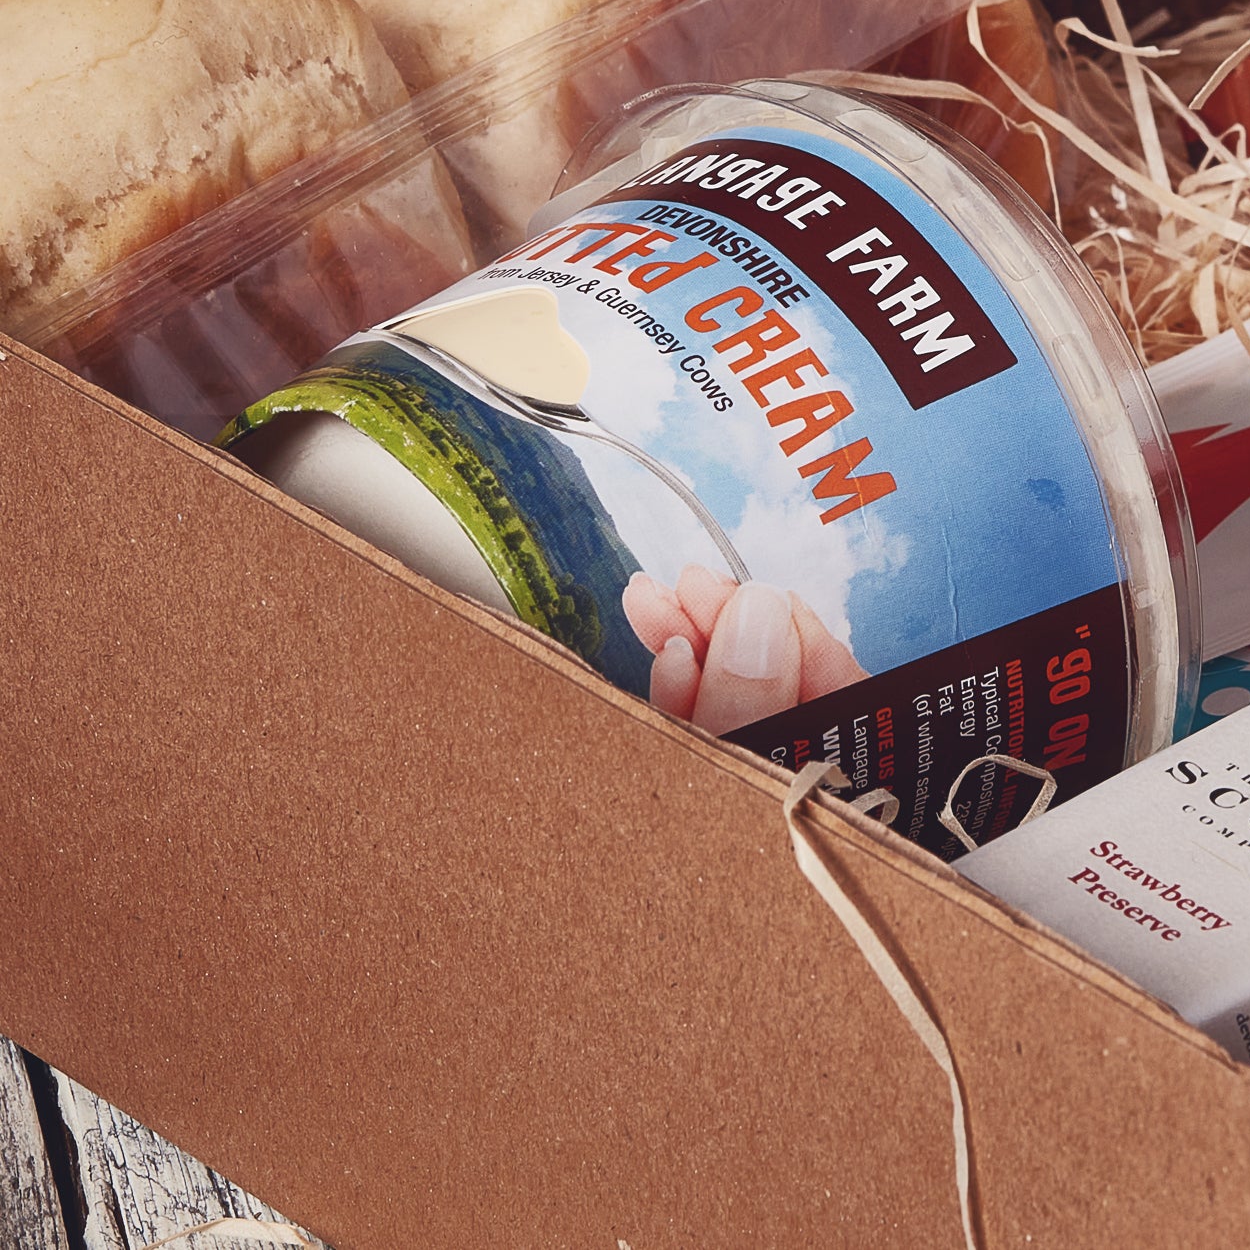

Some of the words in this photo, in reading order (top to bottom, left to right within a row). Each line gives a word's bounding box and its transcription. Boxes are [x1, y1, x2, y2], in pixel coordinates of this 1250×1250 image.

[635, 205, 811, 309] DEVONSHIRE
[825, 227, 976, 373] FARM
[477, 267, 522, 280] from
[519, 266, 582, 289] Jersey
[576, 279, 601, 295] &
[595, 287, 686, 356] Guernsey
[679, 354, 734, 412] Cows
[684, 285, 898, 525] CREAM
[874, 706, 895, 756] GIVE
[911, 693, 934, 721] (of
[937, 683, 955, 716] Fat
[959, 674, 978, 738] Energy
[980, 666, 1002, 732] Typical
[852, 714, 870, 790] Langage
[878, 758, 896, 784] US
[916, 724, 935, 775] which
[1066, 866, 1182, 942] Preserve
[1089, 839, 1233, 932] Strawberry
